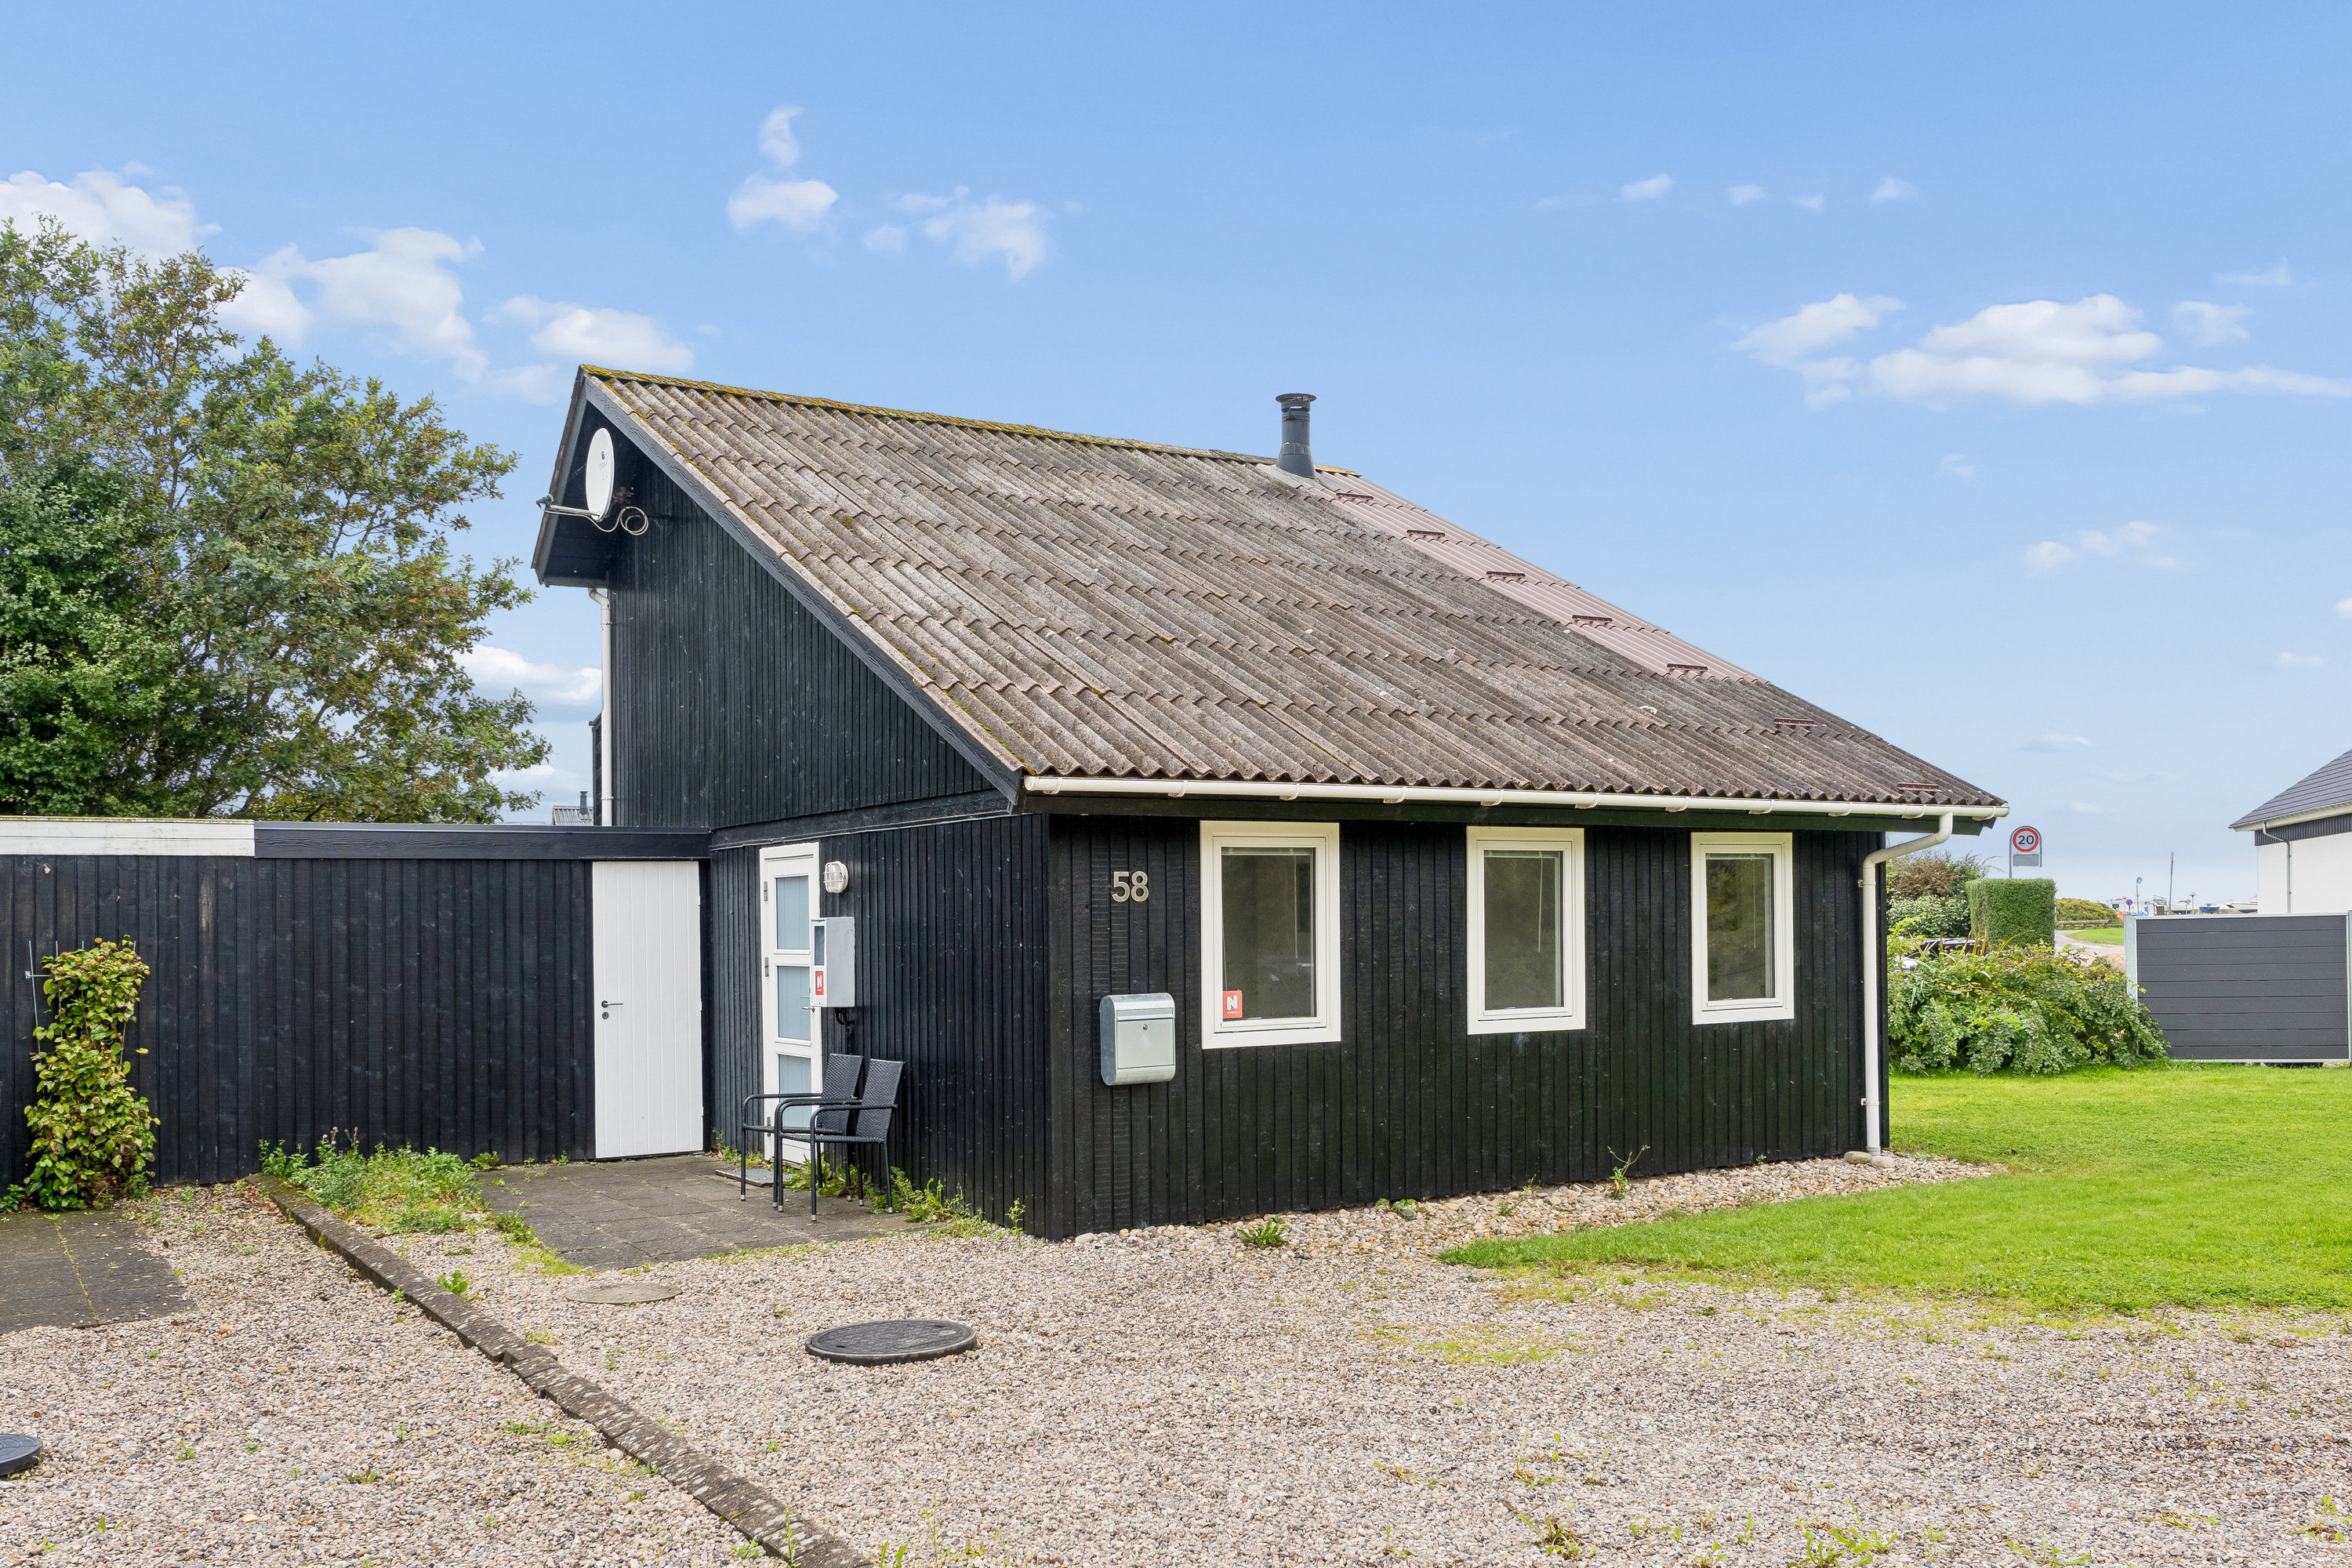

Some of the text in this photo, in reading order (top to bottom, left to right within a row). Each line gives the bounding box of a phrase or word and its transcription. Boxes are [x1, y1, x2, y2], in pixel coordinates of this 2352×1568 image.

[2018, 835, 2034, 845] 20
[1112, 871, 1149, 902] 58
[817, 975, 822, 989] N
[1227, 995, 1238, 1011] N
